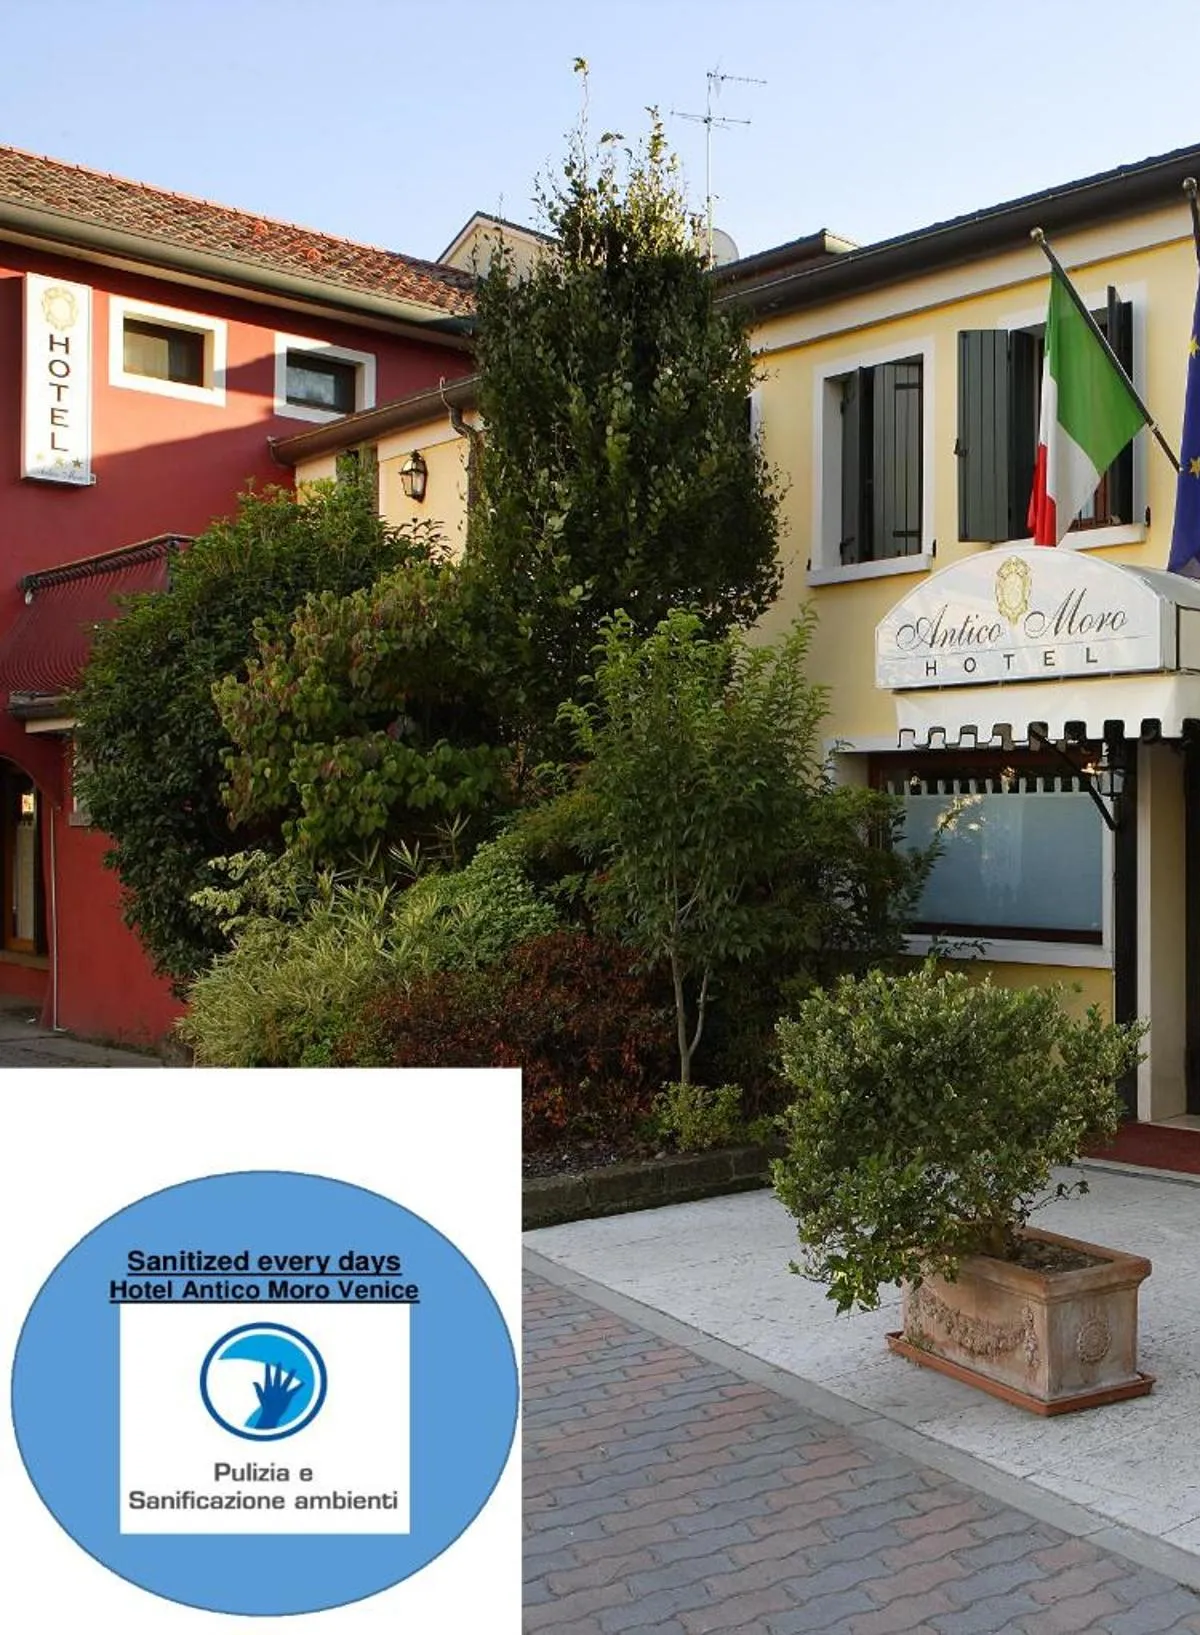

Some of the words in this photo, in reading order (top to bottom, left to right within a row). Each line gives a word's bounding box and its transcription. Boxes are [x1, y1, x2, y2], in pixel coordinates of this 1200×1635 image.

[48, 334, 70, 452] HOTEL
[896, 604, 1002, 651] Antico
[1024, 588, 1129, 638] Moro
[925, 647, 1099, 677] HOTEL
